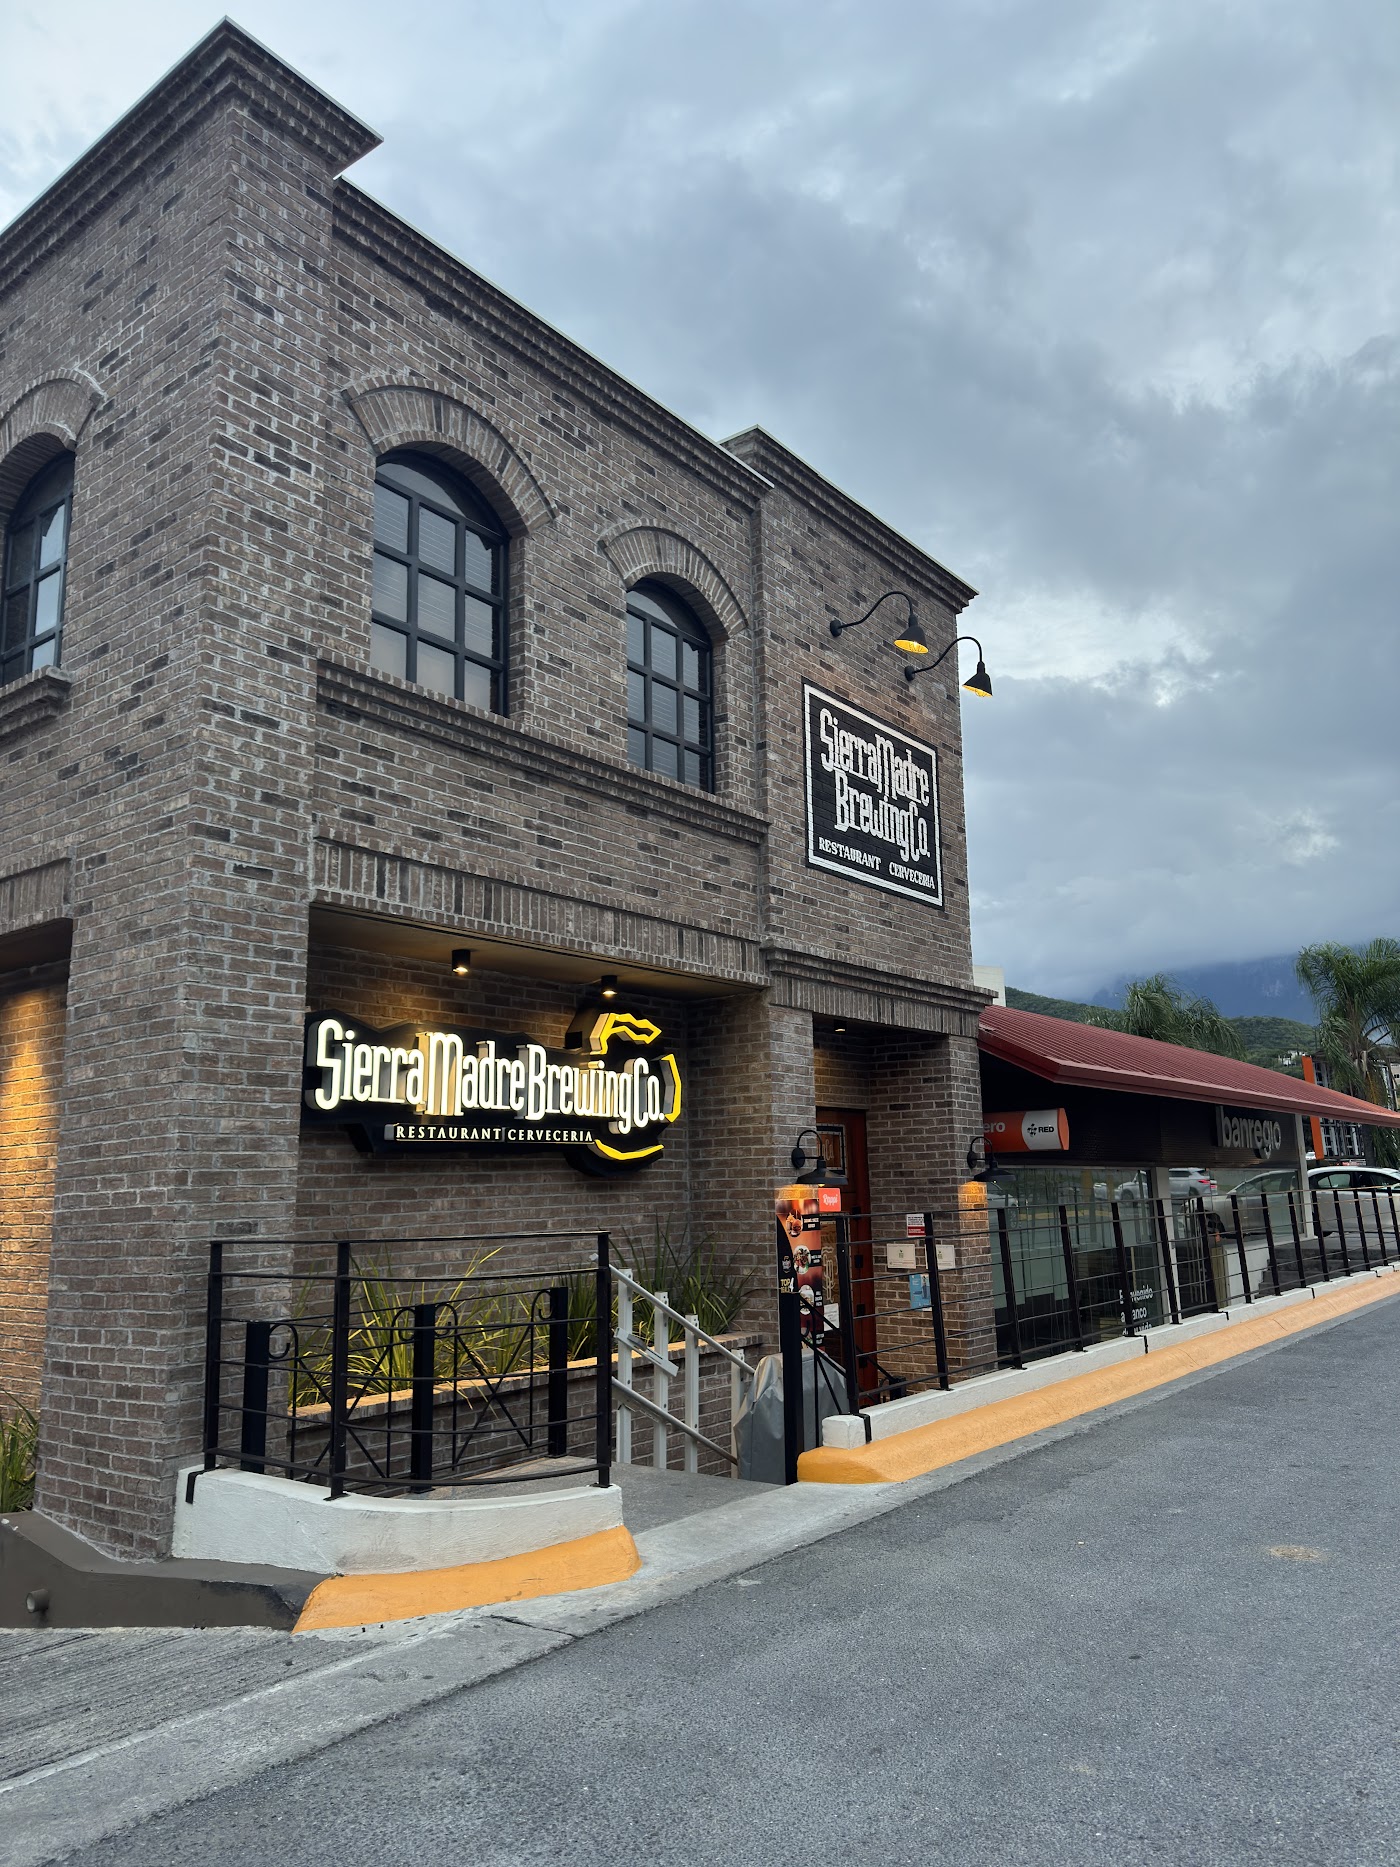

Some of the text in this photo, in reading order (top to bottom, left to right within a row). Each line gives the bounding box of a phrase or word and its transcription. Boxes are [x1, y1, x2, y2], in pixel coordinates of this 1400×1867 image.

[818, 837, 936, 889] RESTAURANT CERVECERIA
[396, 1124, 593, 1142] RESTAURANT CERVECERIA
[1131, 1307, 1147, 1320] anco
